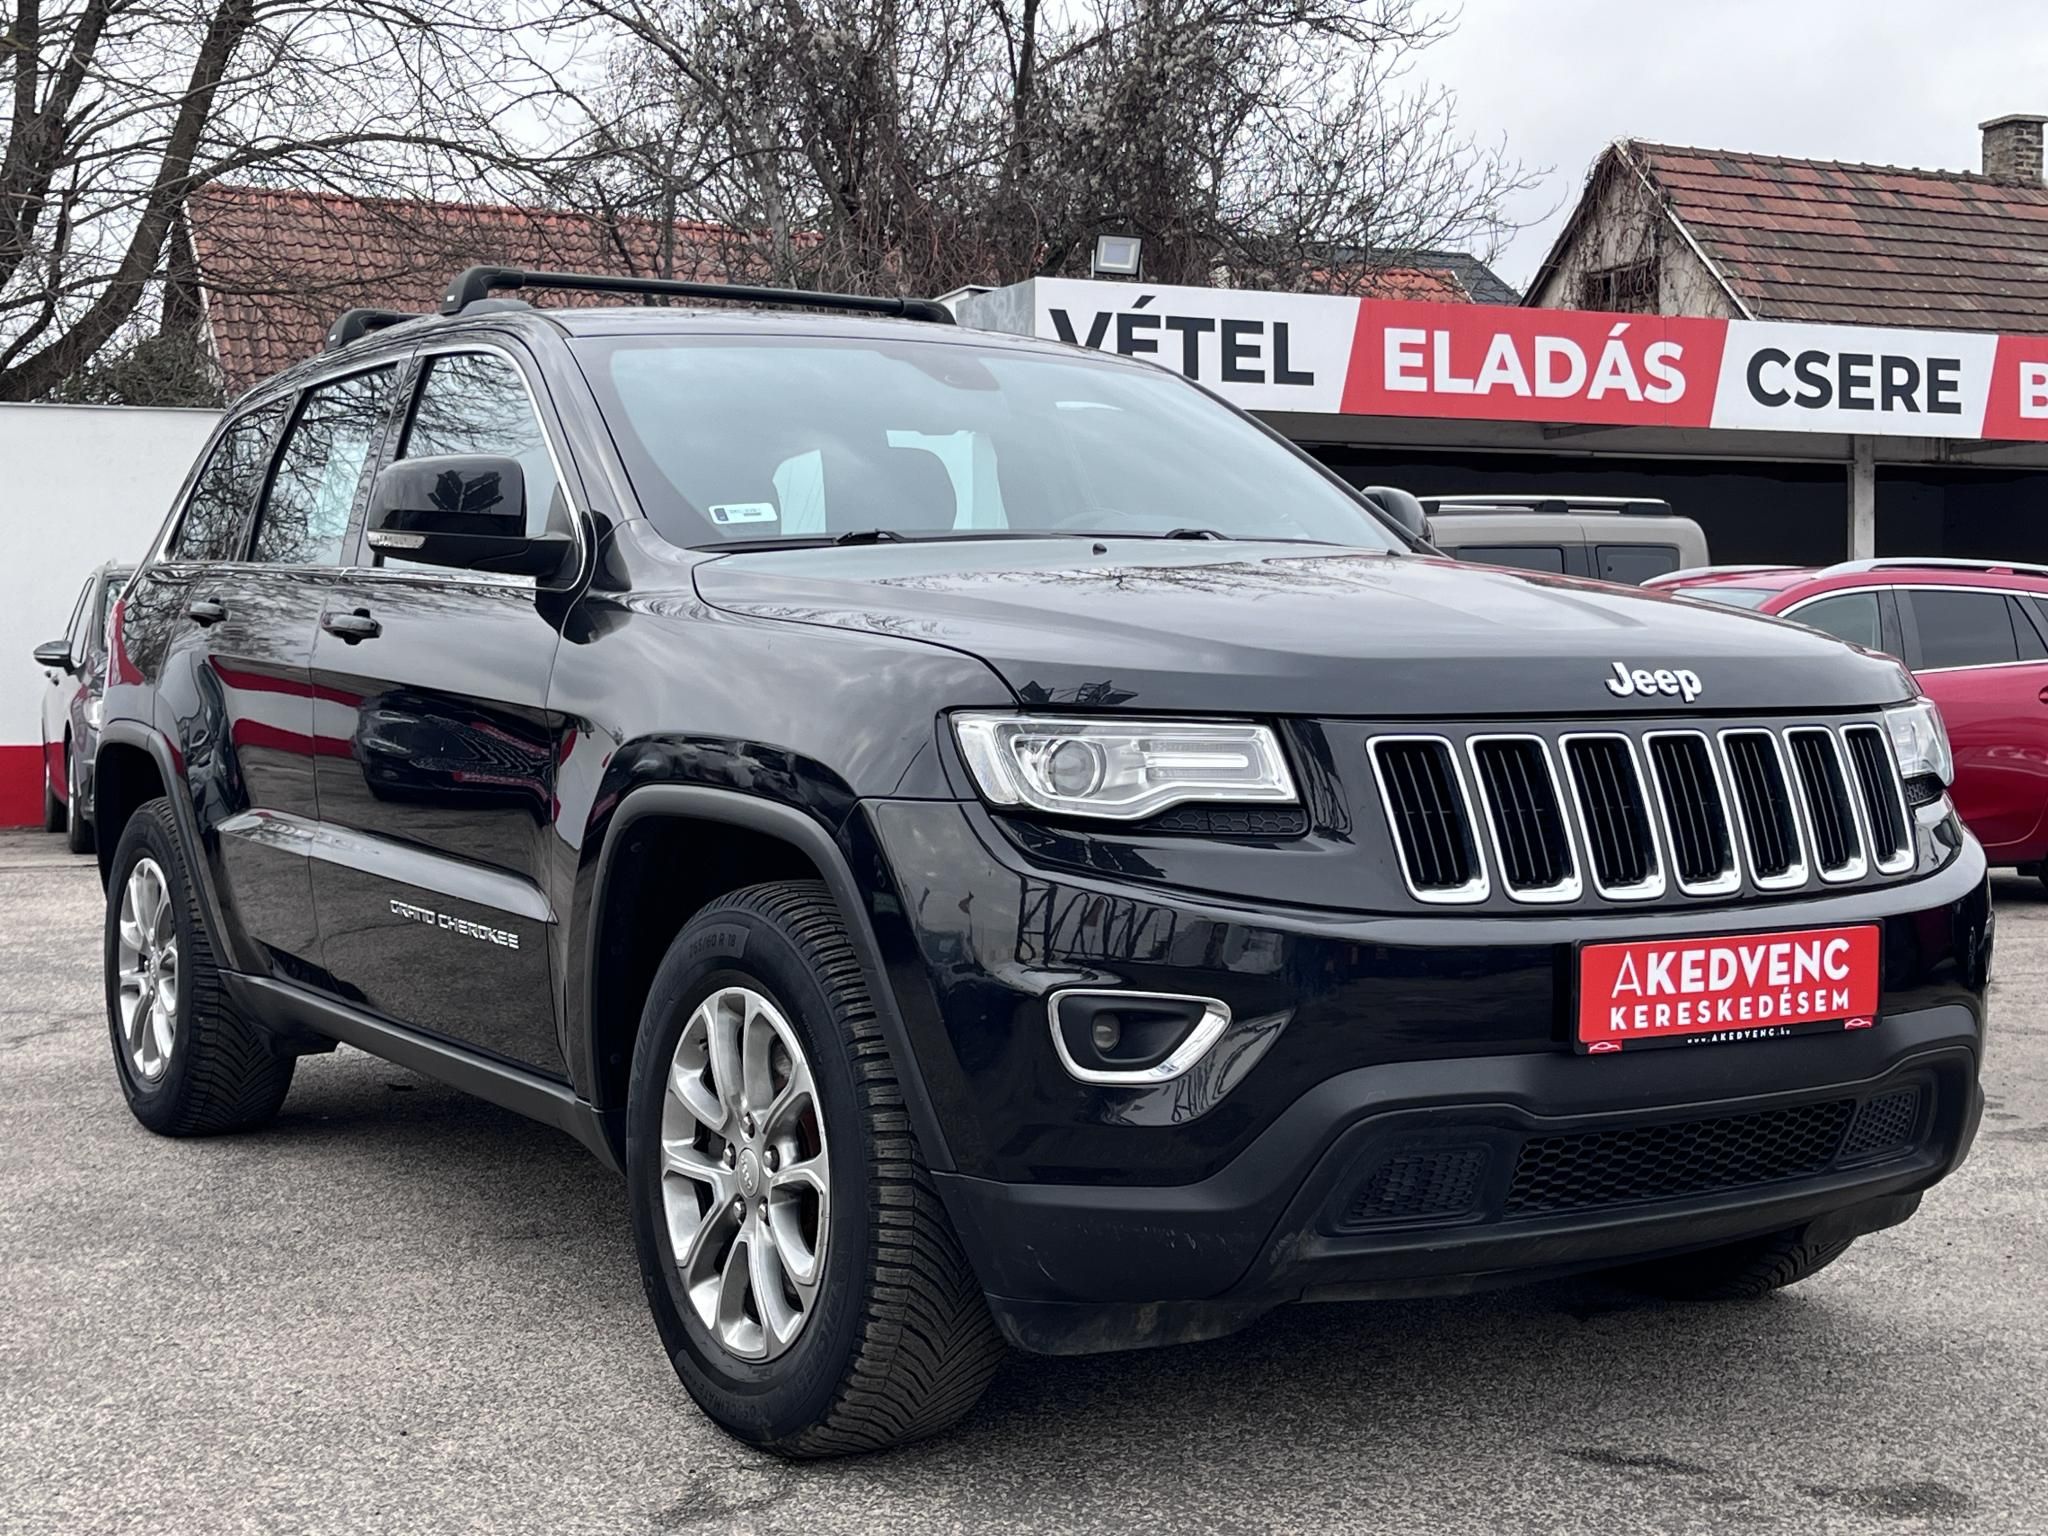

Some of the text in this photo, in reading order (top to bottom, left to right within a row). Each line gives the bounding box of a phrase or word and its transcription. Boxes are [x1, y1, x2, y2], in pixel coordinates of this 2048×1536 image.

[1048, 295, 1314, 386] VÉTEL
[1384, 322, 1687, 404] ELADÁS
[1746, 347, 1962, 415] CSERE
[1604, 661, 1703, 704] Jeep
[390, 899, 520, 949] GRAND CHEROKEE
[1610, 986, 1849, 1031] KERESKEDÉSEM
